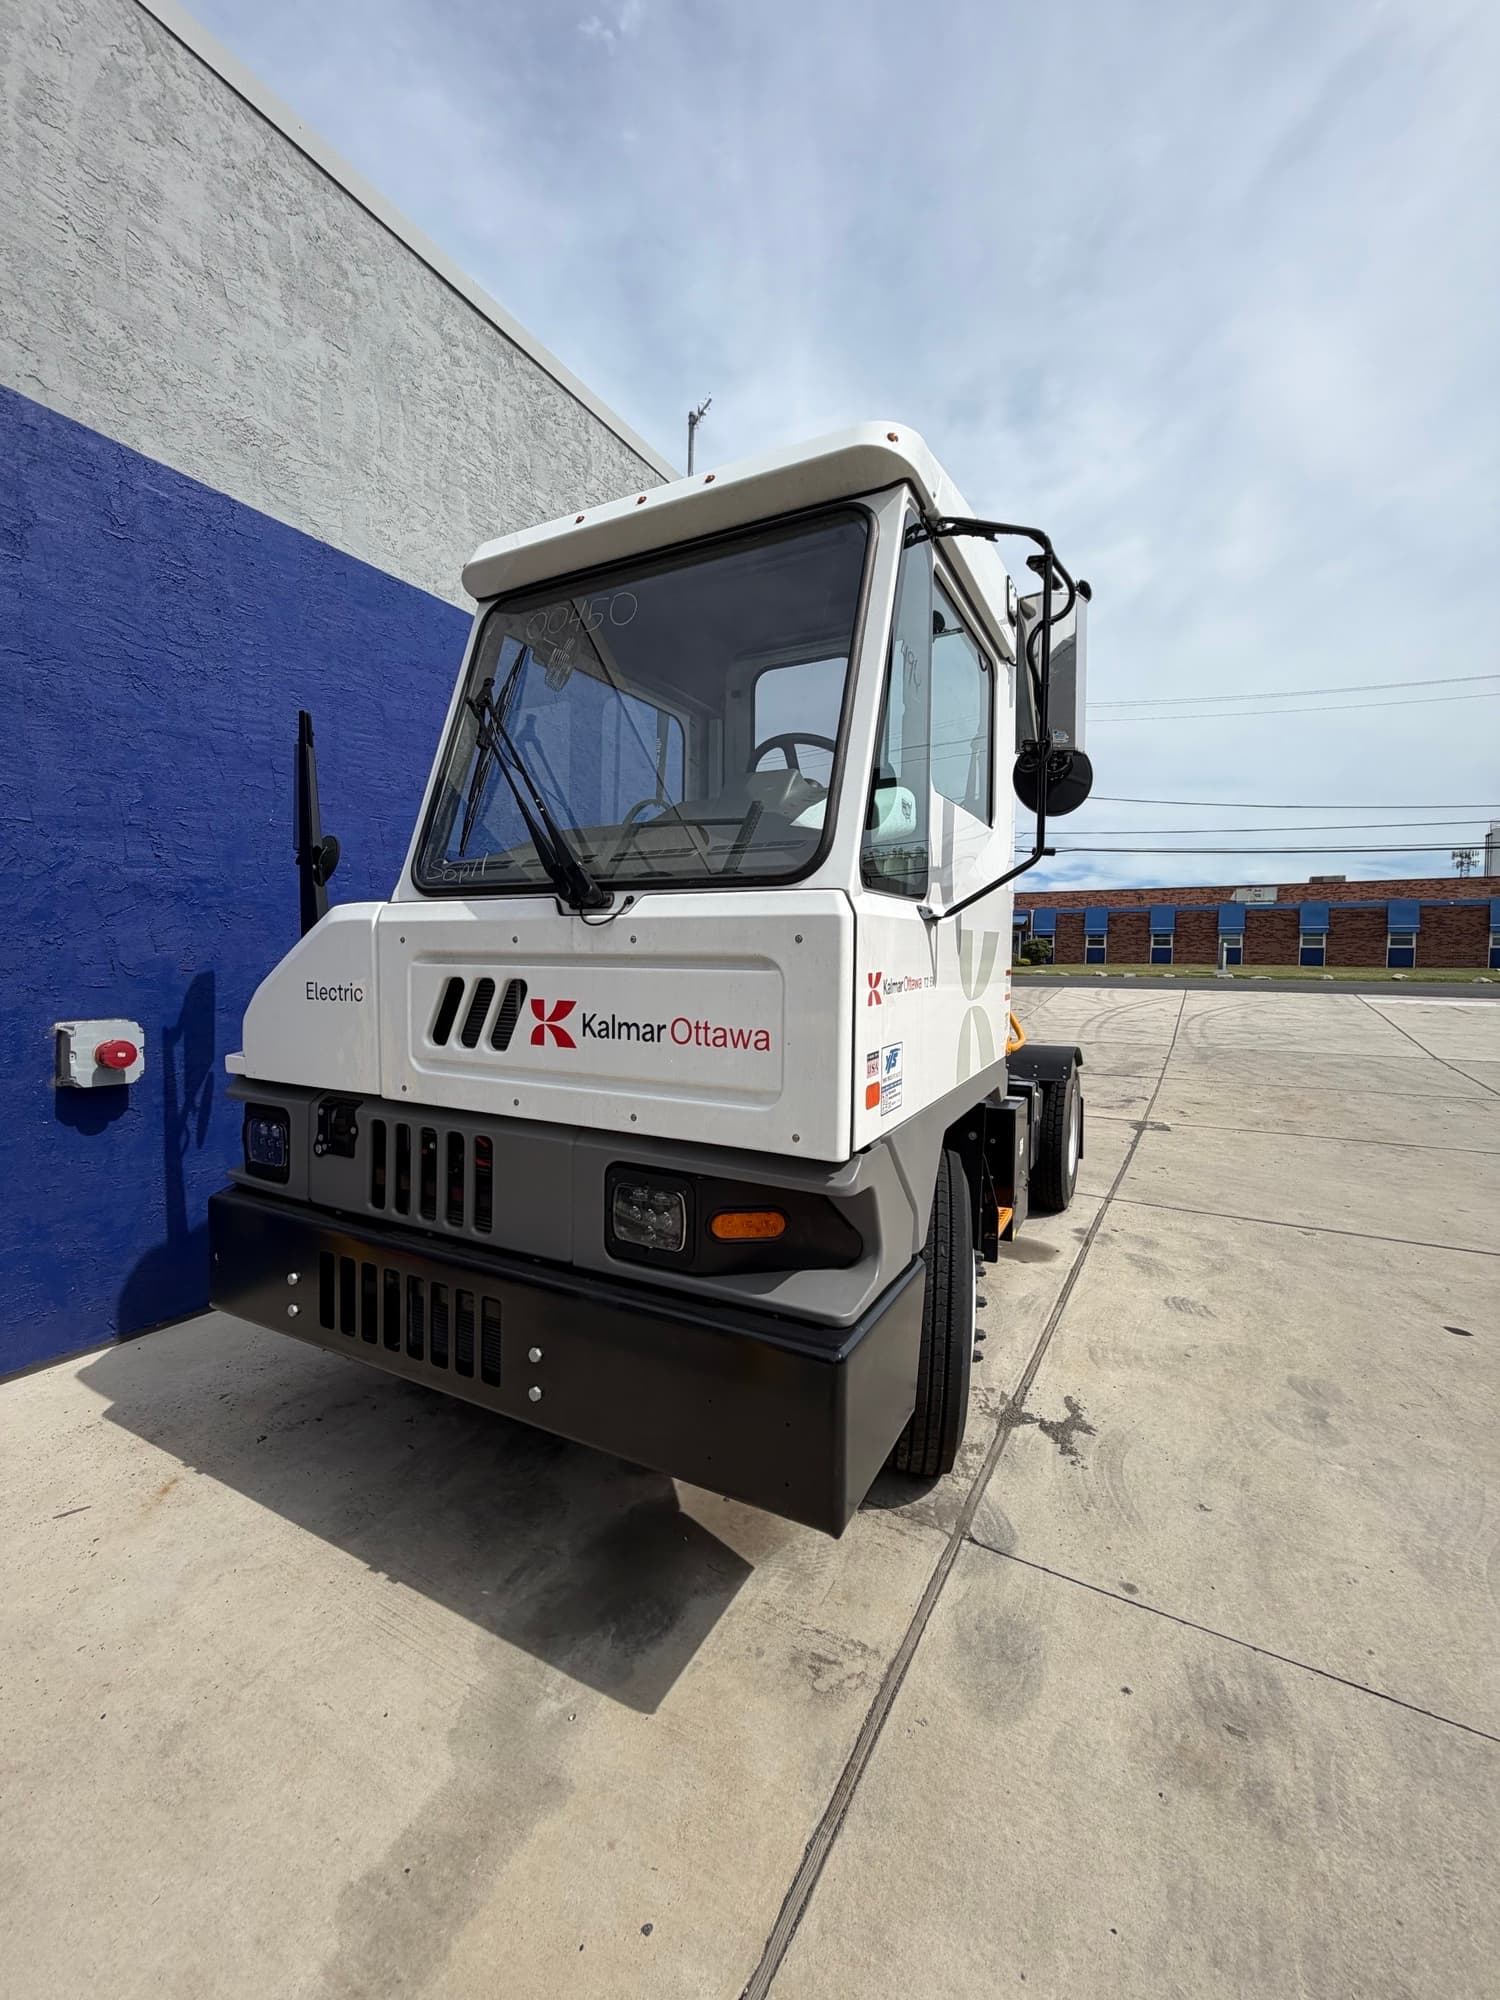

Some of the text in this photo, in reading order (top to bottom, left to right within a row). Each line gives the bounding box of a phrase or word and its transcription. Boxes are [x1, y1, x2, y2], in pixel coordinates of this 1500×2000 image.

[305, 981, 364, 1002] Electric
[581, 1012, 667, 1043] Kalmar
[670, 1016, 771, 1052] Ottawa
